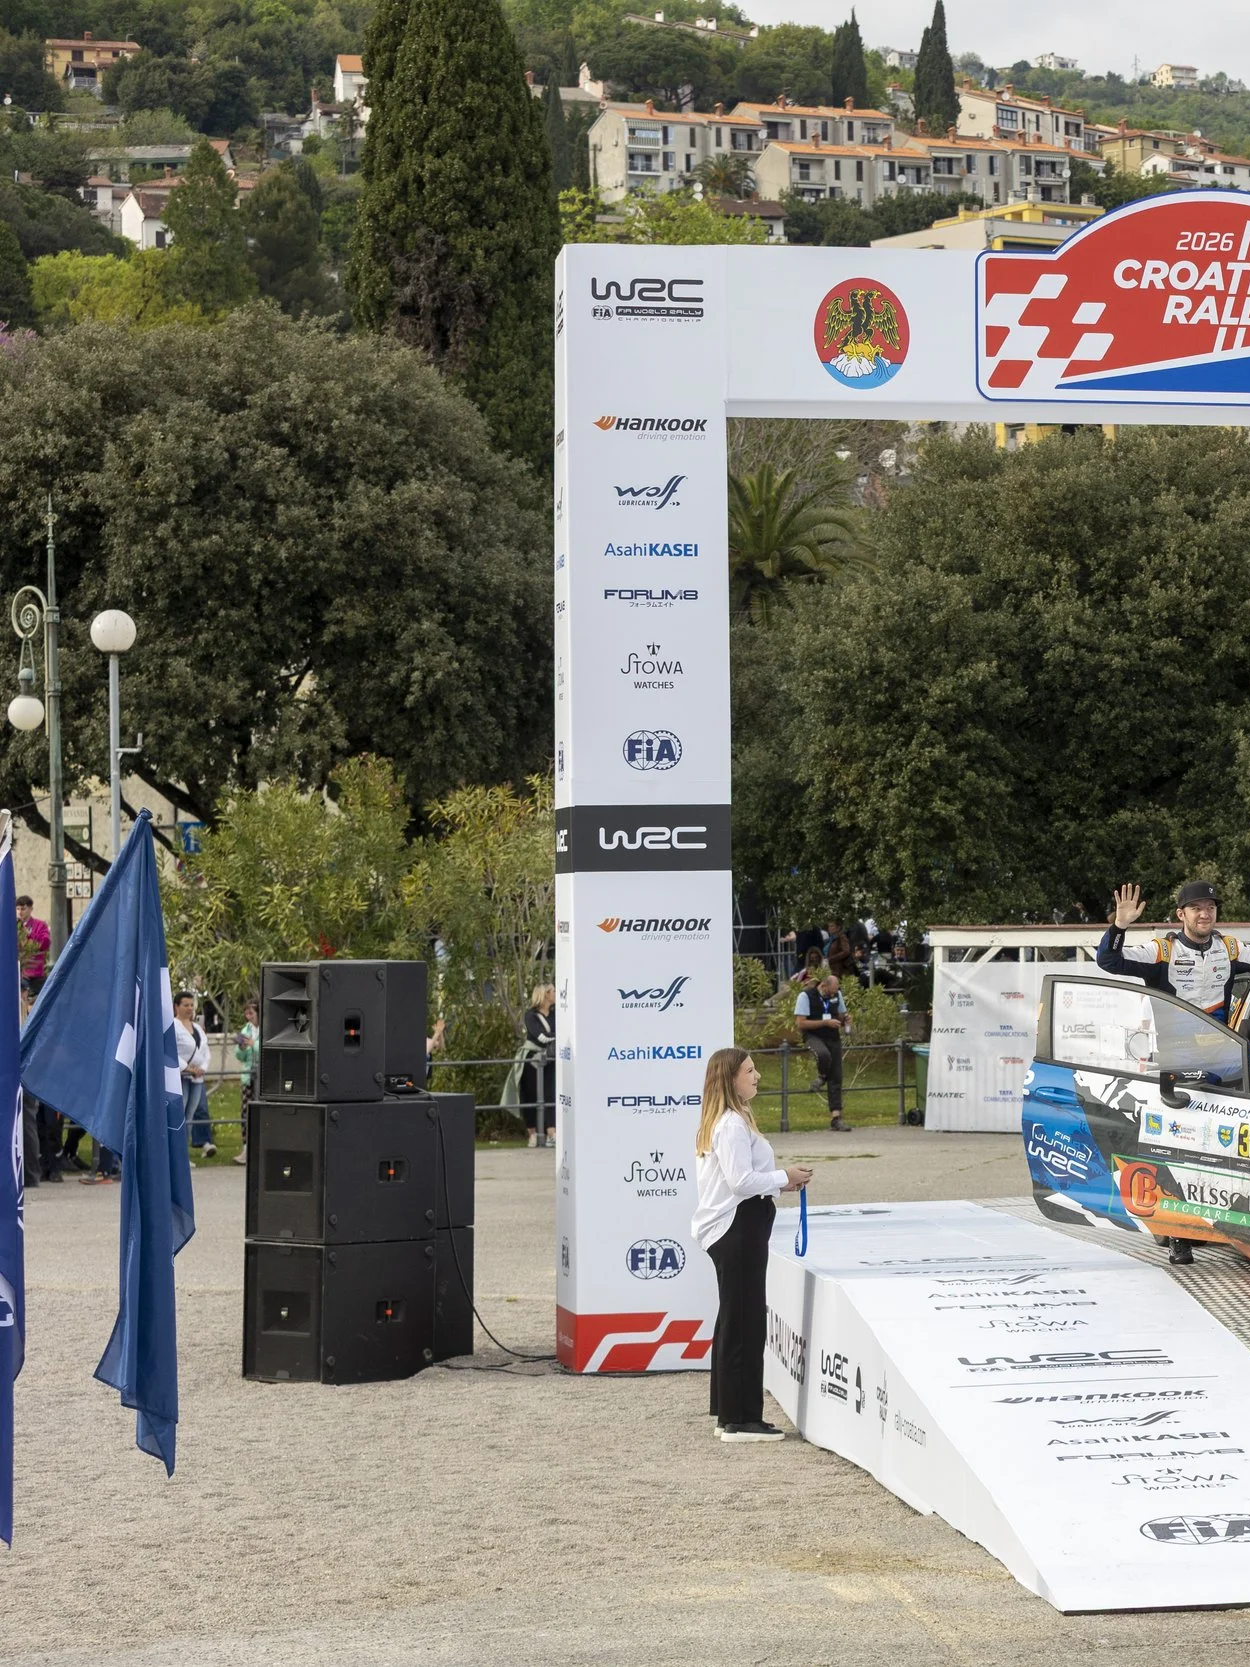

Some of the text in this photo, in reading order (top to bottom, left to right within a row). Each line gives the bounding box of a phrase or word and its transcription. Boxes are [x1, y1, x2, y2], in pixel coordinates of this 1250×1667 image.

[1176, 231, 1234, 251] 2026
[591, 277, 704, 303] WRC
[637, 432, 706, 441] driving emotion
[604, 589, 699, 600] FORUM8
[620, 652, 684, 675] STOWA
[633, 681, 675, 690] WATCHES
[599, 826, 707, 850] WRC
[641, 932, 710, 942] driving emotion
[607, 1095, 702, 1107] FORUM8
[1054, 1131, 1071, 1142] FIA
[1034, 1132, 1087, 1161] JUNIOR
[1028, 1141, 1088, 1180] WRC
[624, 1161, 687, 1182] STOWA
[636, 1188, 678, 1197] WATCHES
[1163, 1200, 1231, 1222] BYGGARE
[978, 1319, 1089, 1329] STOWA
[957, 1349, 1168, 1366] WRC
[821, 1349, 849, 1384] WRC
[1056, 1447, 1246, 1461] FORUM8
[1111, 1473, 1240, 1486] STOWA
[1143, 1483, 1227, 1491] WATCHES
